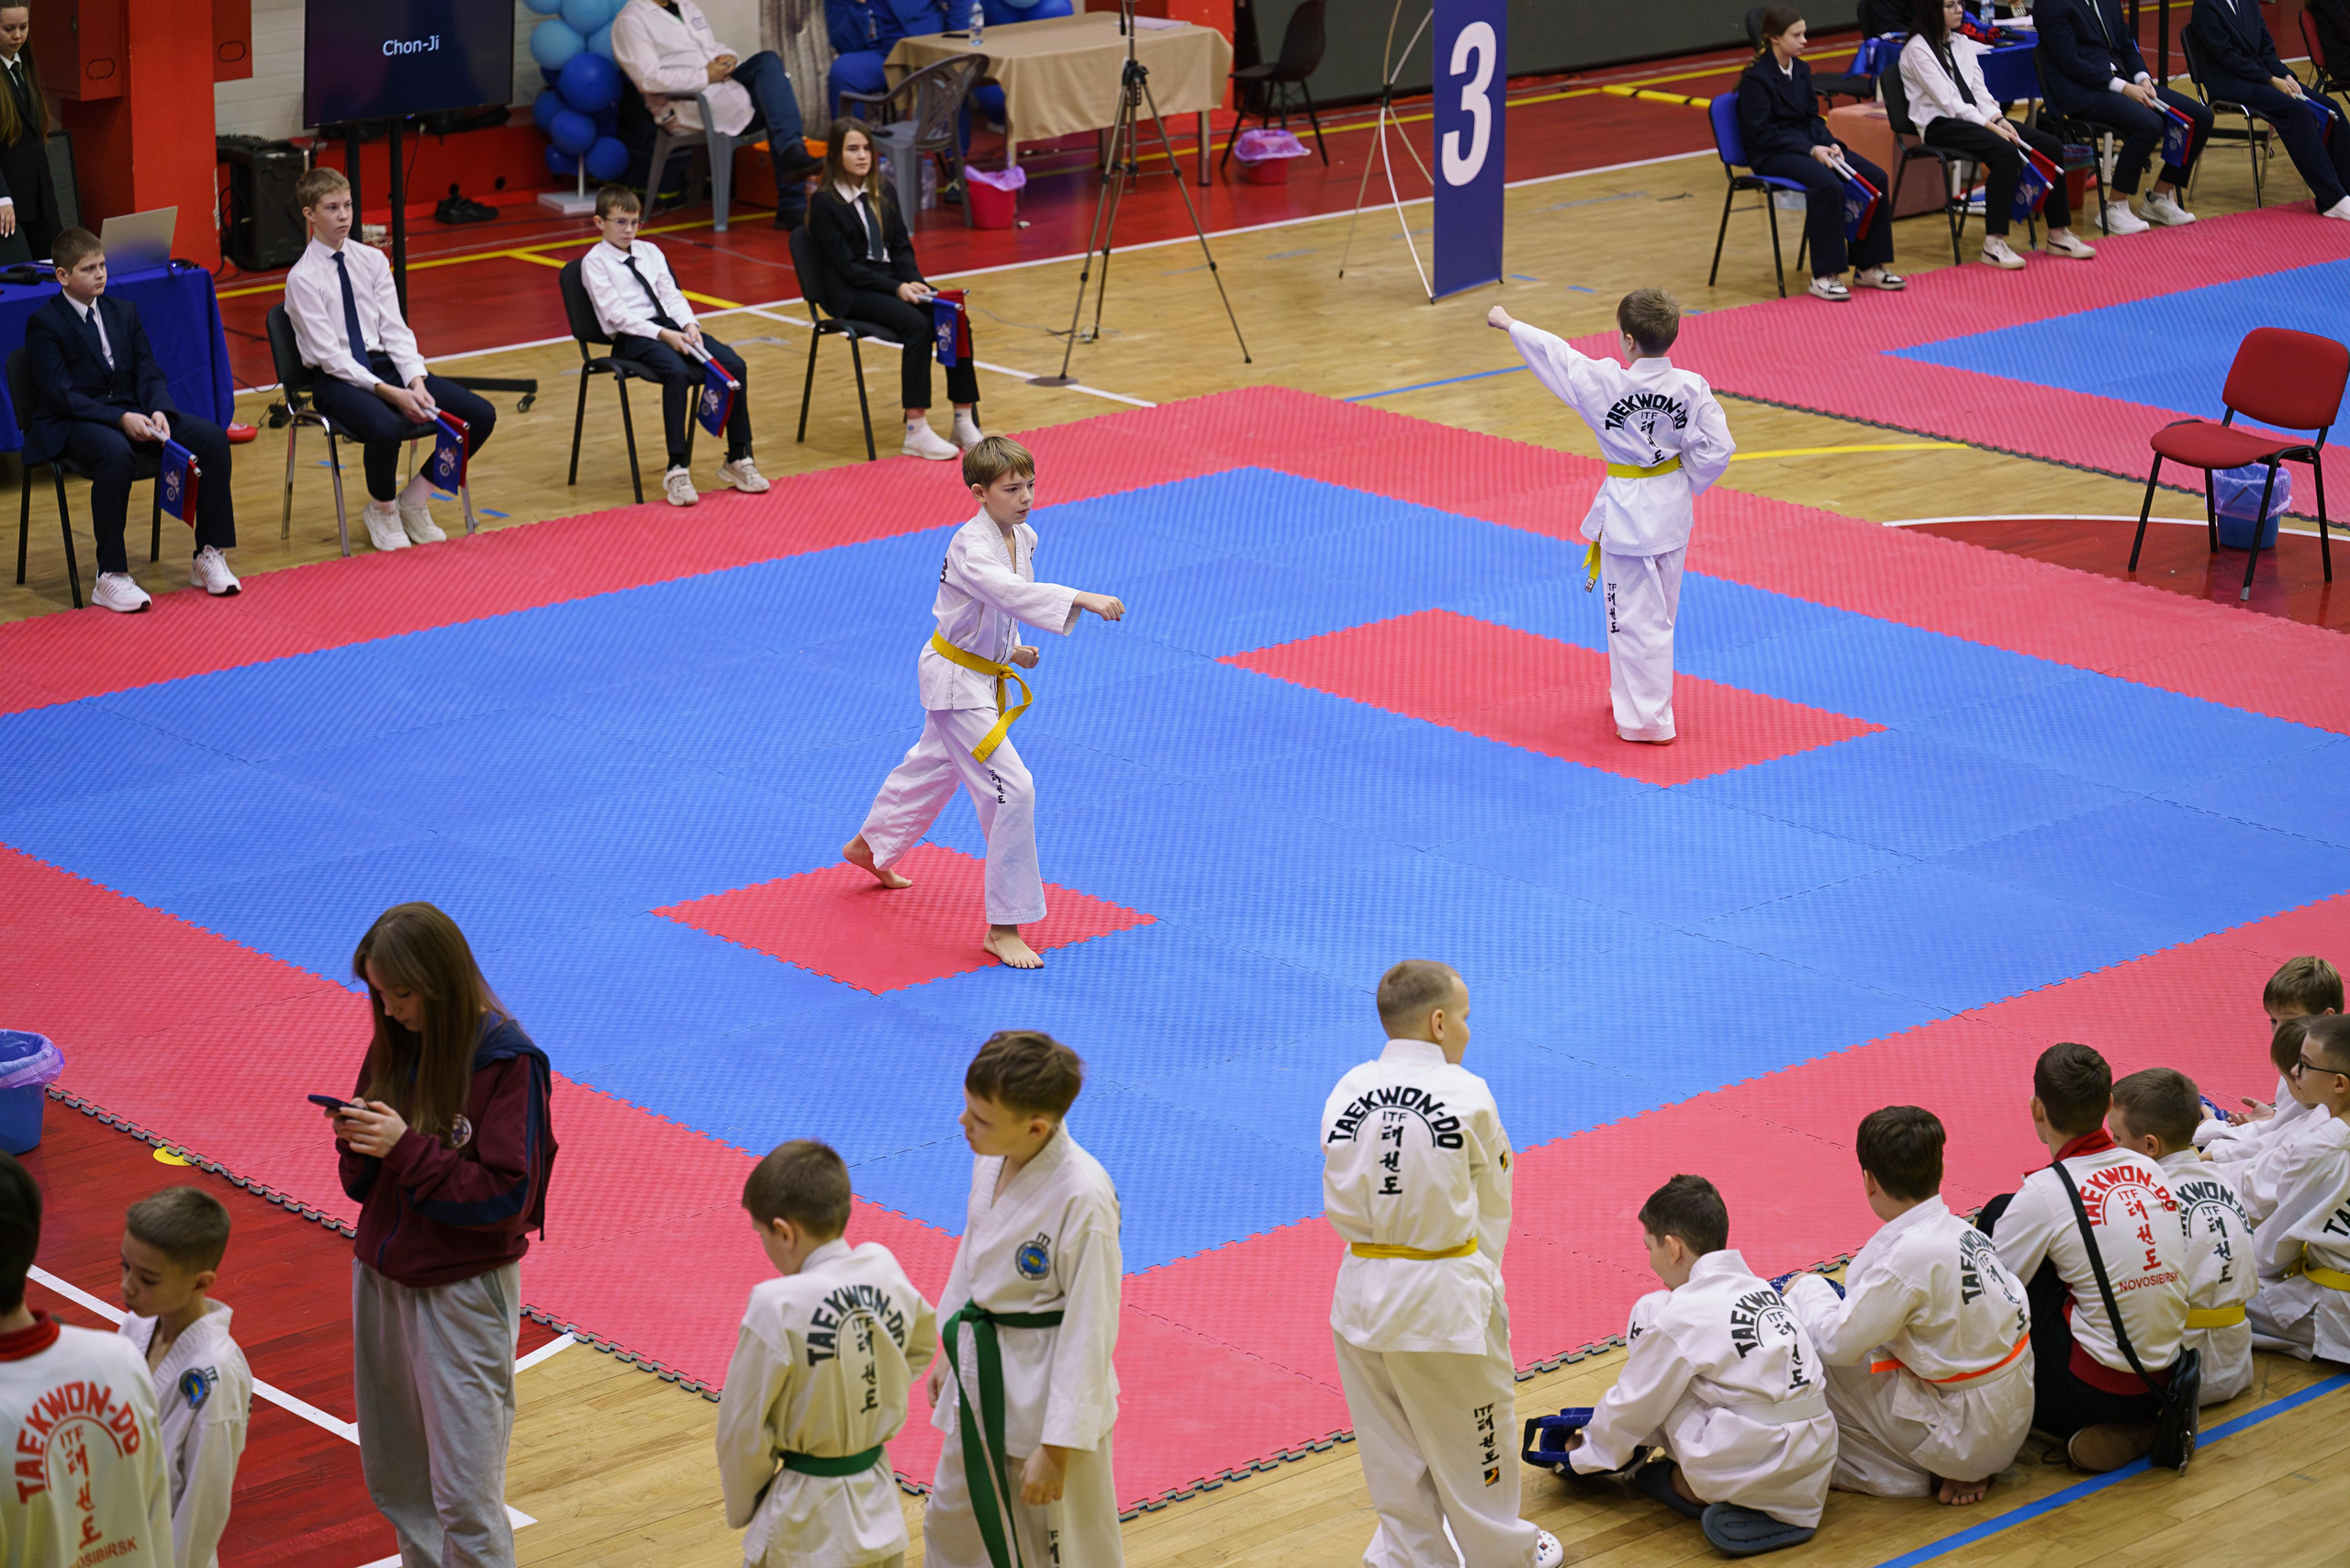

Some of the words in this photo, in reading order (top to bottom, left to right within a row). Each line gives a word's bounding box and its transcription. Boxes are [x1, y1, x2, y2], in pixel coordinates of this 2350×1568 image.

[383, 35, 440, 56] Chon-Ji
[1441, 20, 1497, 186] 3
[1605, 393, 1688, 431] TAEKWON-DO
[1640, 411, 1658, 420] ITF
[1327, 1086, 1464, 1149] TAEKWON-DO
[1382, 1111, 1408, 1123] ITF
[1378, 1126, 1404, 1194] 태권도
[2118, 1189, 2138, 1201] ITF
[2200, 1205, 2221, 1215] ITF
[1978, 1253, 1989, 1268] ITF
[2119, 1271, 2180, 1293] NOVOSIBIRSK
[852, 1316, 873, 1330] ITF
[1766, 1311, 1785, 1323] ITF
[1474, 1403, 1494, 1417] ITF
[15, 1381, 140, 1505] TAEKWON-DO
[60, 1425, 85, 1449] ITF
